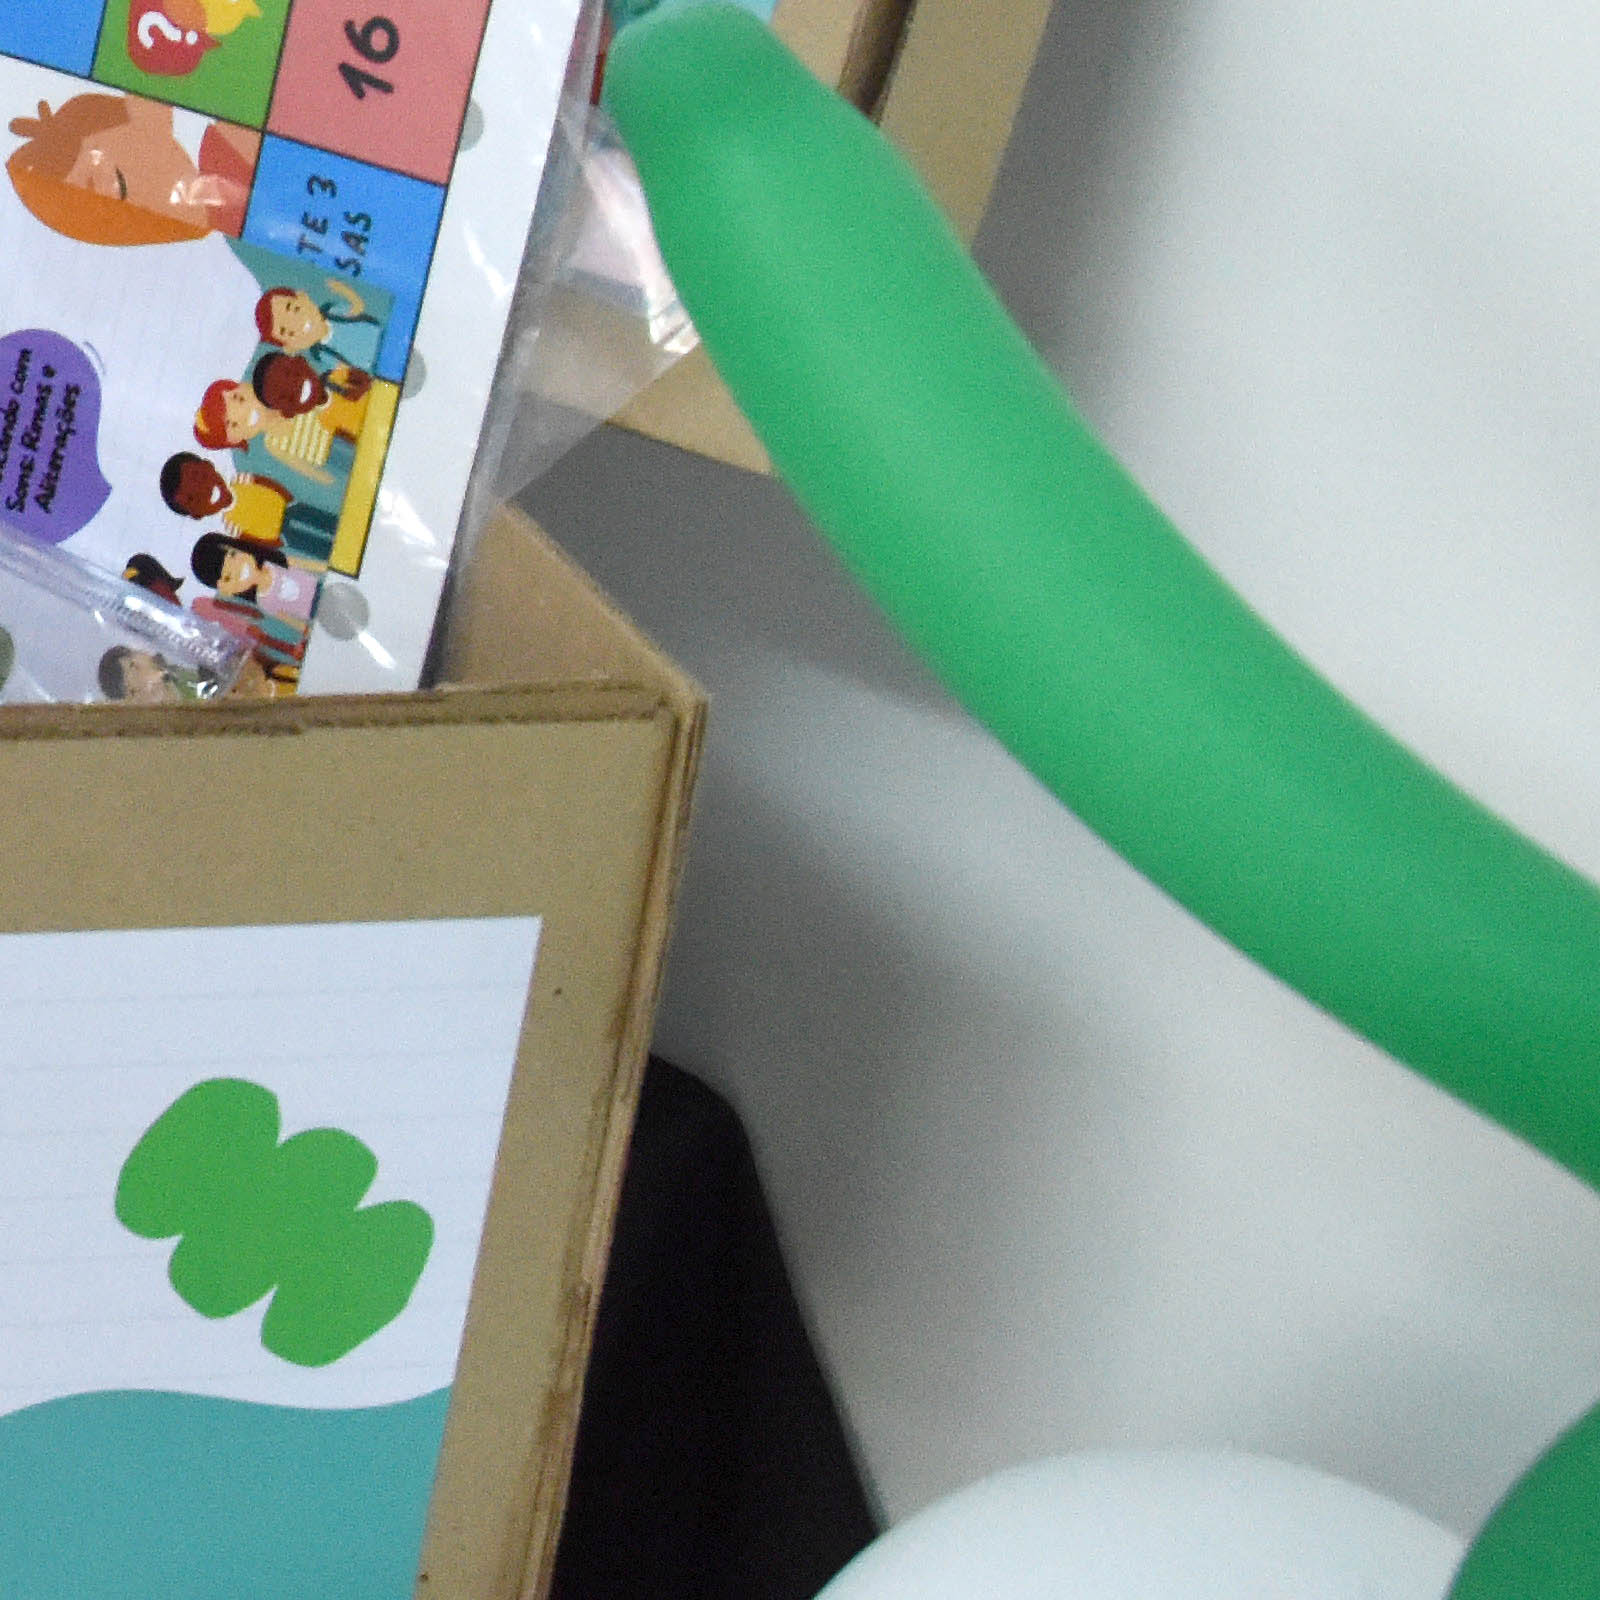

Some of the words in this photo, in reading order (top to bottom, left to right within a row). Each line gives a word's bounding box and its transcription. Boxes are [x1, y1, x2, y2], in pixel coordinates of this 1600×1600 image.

[344, 13, 404, 102] 16
[307, 174, 338, 198] 3
[11, 348, 33, 395] com
[20, 383, 54, 453] Rimas
